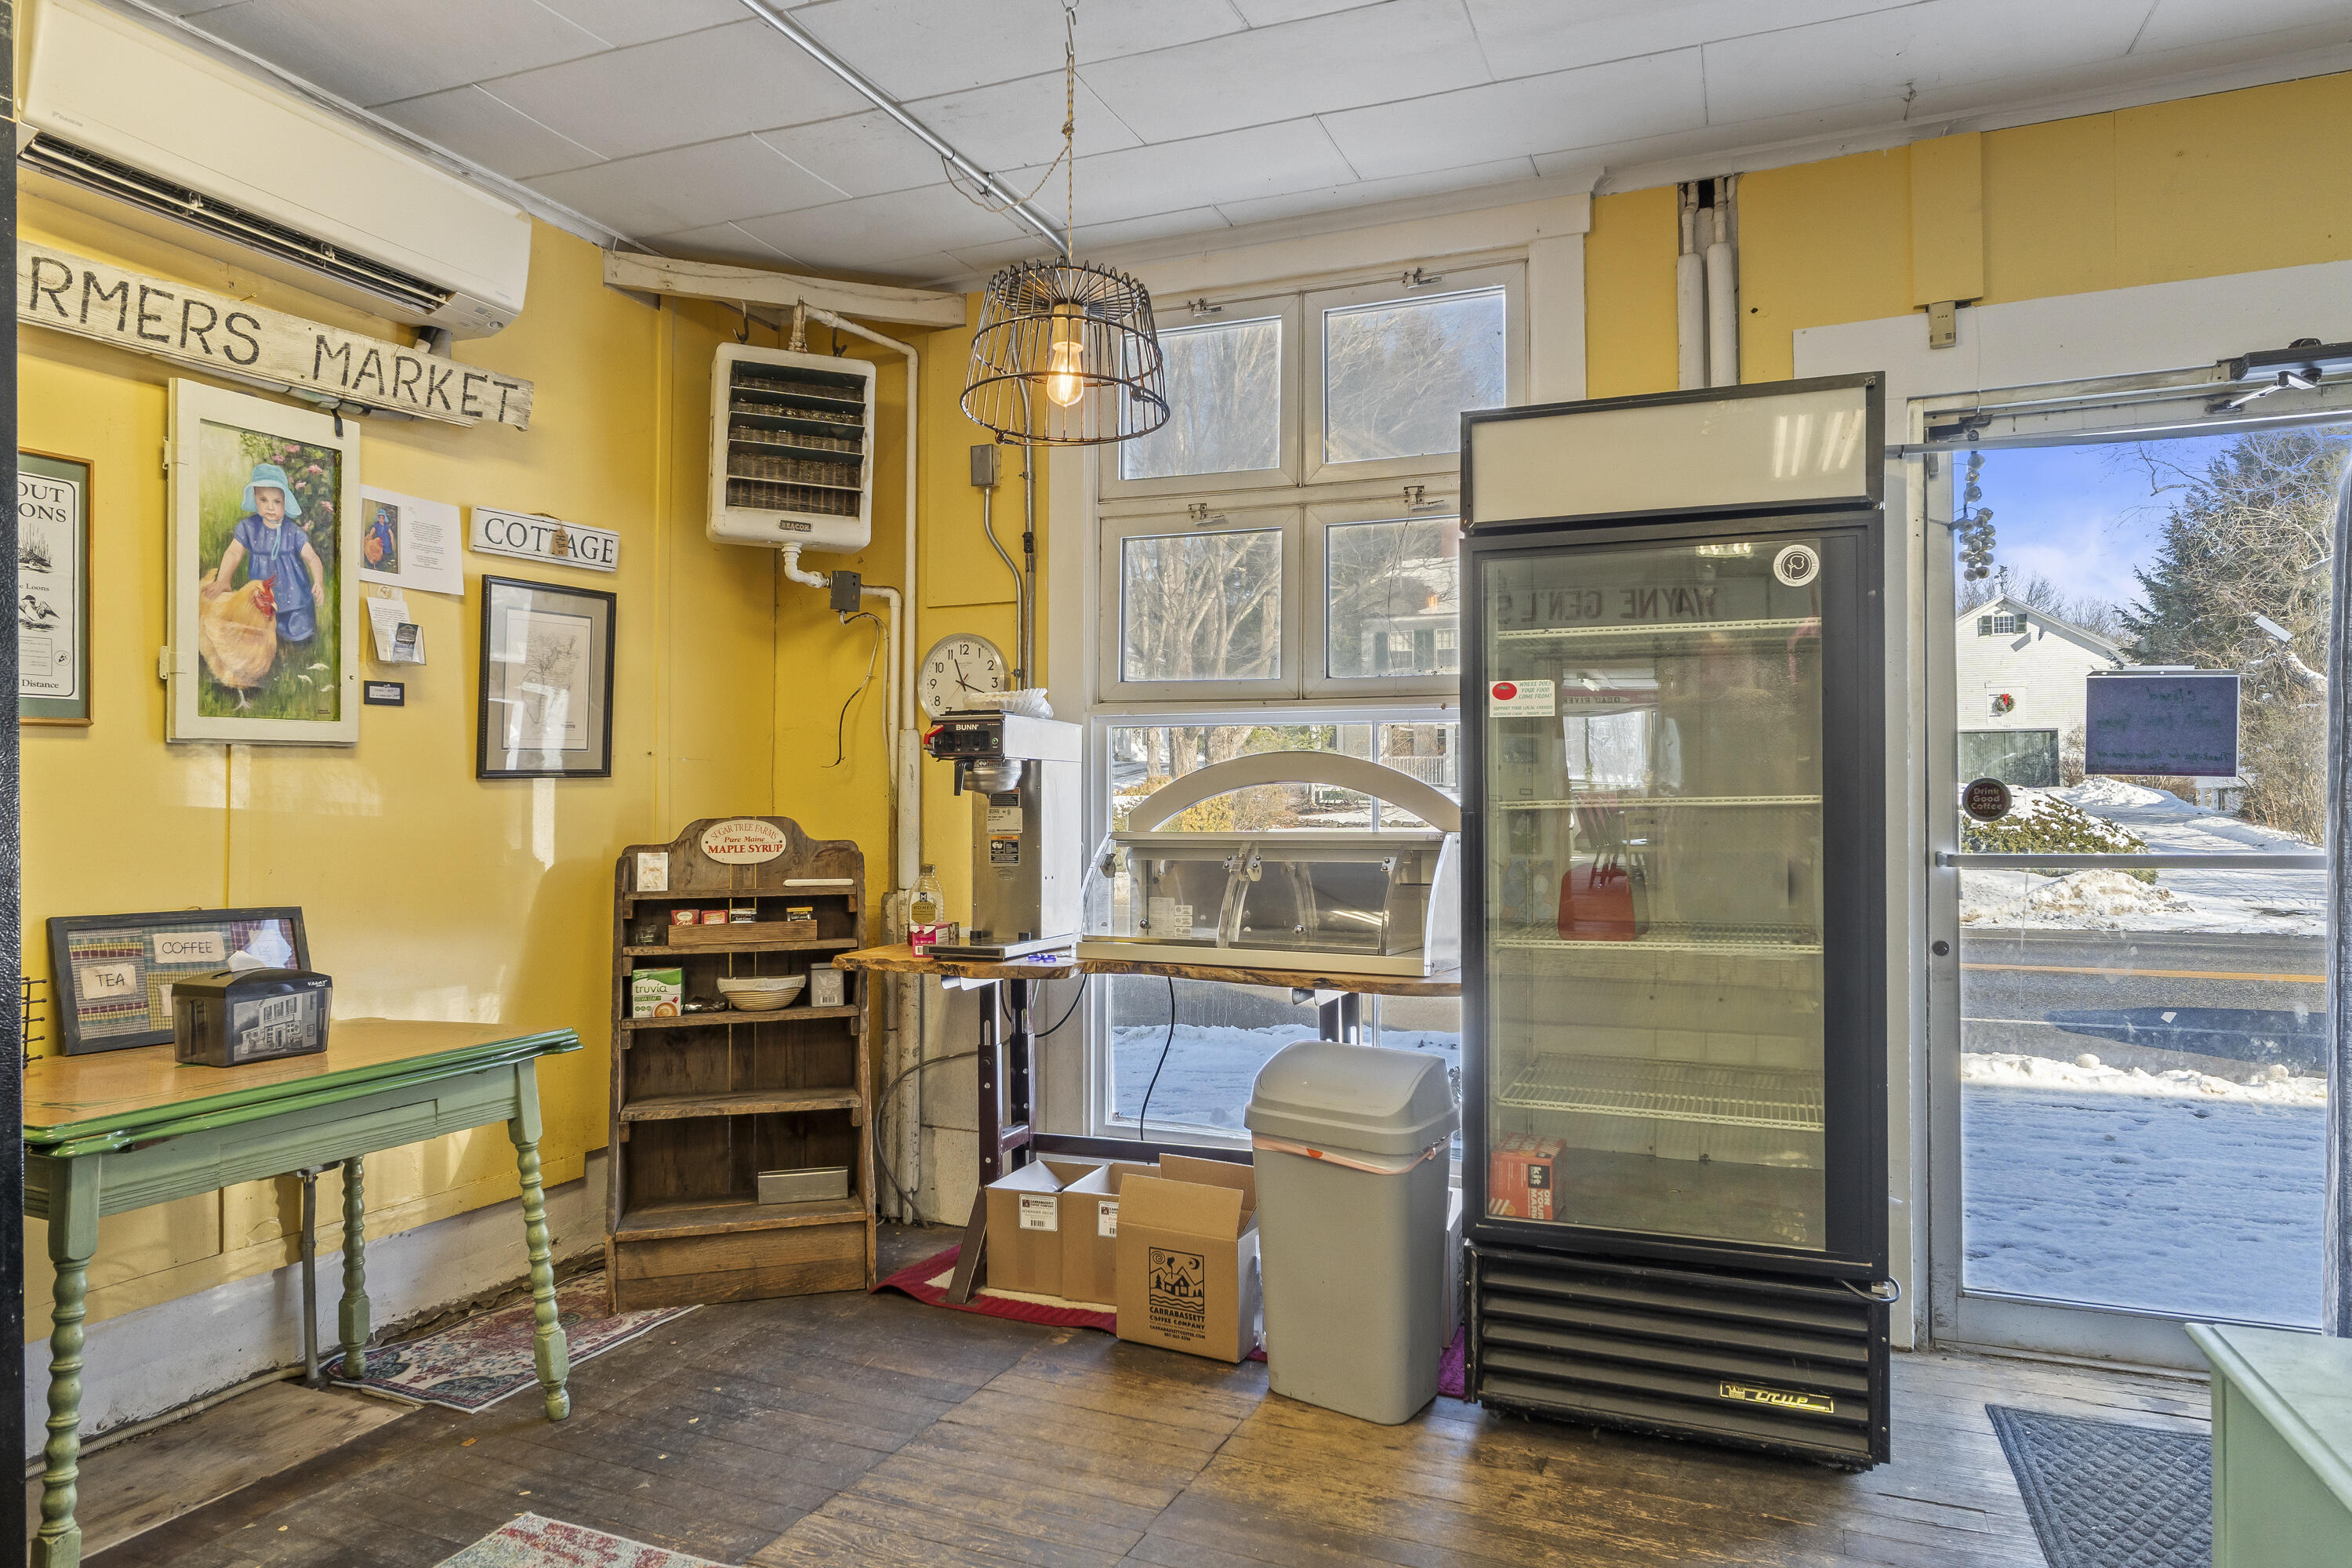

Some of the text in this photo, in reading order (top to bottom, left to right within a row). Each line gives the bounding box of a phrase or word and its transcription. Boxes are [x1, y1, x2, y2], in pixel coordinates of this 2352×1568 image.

[30, 256, 518, 423] RMERS MARKET
[485, 517, 614, 564] COTAGE
[26, 583, 49, 592] Loons
[948, 649, 953, 659] 11
[960, 644, 970, 655] 12
[978, 648, 981, 659] 1
[935, 662, 945, 673] 10
[987, 660, 994, 671] 2
[22, 679, 60, 688] Distance
[930, 678, 938, 689] 9
[991, 677, 999, 688] 3
[934, 695, 941, 706] 8
[710, 823, 778, 840] SUGAR TREE FARMS
[708, 844, 783, 854] MAPLE SYRUP
[162, 941, 213, 955] COFFEE
[95, 973, 125, 987] TEA
[1544, 1190, 1551, 1206] ON
[1149, 1306, 1205, 1323] CARRABASSETT
[1149, 1315, 1171, 1324] COFFEE
[1174, 1319, 1205, 1330] COMPANY
